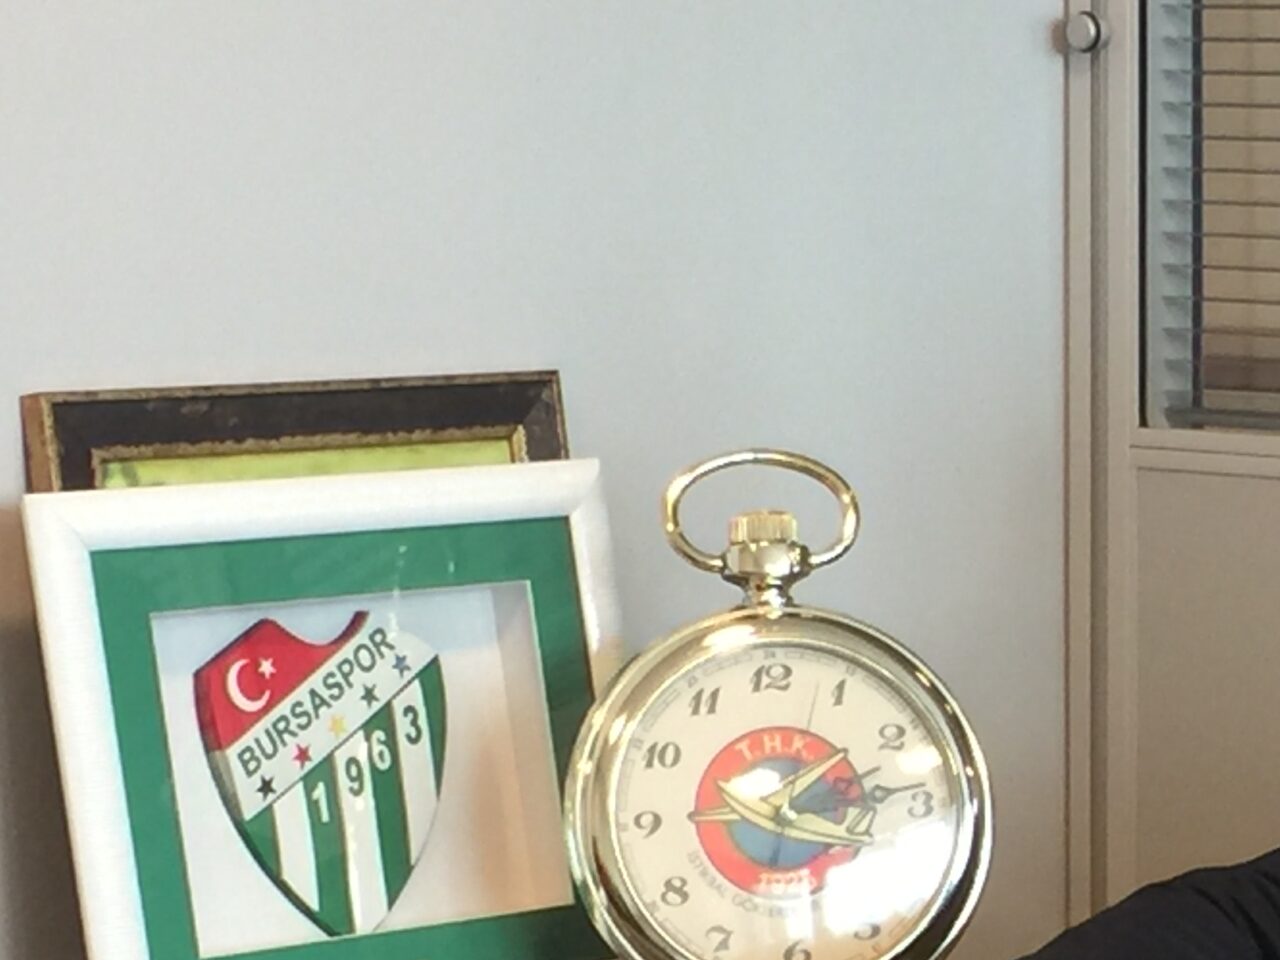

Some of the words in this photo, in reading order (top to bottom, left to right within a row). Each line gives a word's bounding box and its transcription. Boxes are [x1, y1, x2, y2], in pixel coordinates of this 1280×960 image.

[749, 662, 793, 694] 12
[830, 677, 848, 707] 1
[237, 627, 397, 778] BURSASPOR
[687, 685, 721, 717] 11
[877, 722, 907, 752] 2
[311, 704, 424, 824] 1963
[640, 740, 682, 770] 10
[906, 790, 935, 819] 3
[633, 811, 663, 840] 9
[660, 876, 690, 906] 8
[704, 924, 734, 953] 7
